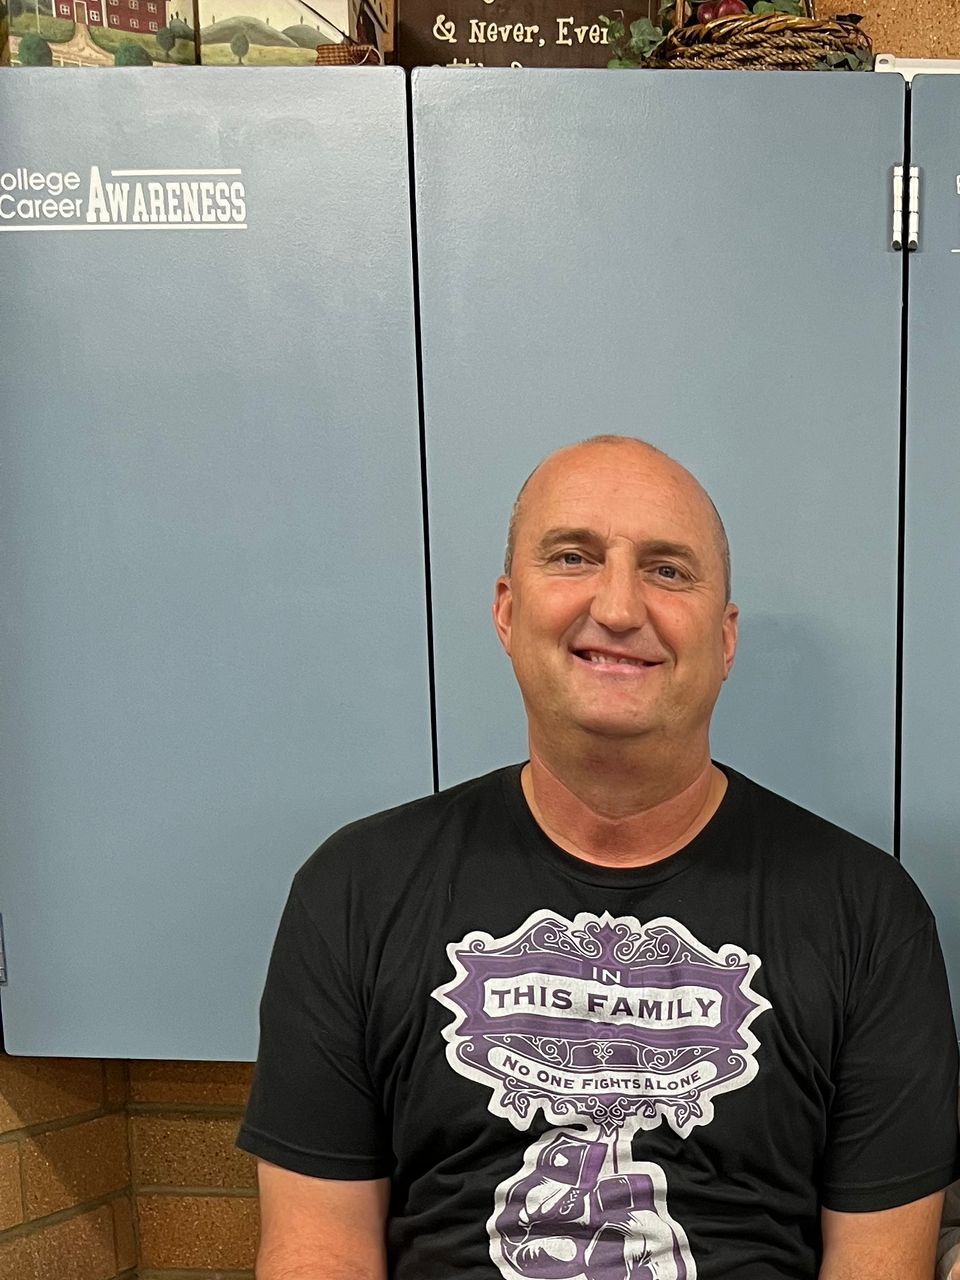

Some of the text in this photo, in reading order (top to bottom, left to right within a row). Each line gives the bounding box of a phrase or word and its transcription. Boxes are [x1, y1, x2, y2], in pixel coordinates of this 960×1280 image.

[433, 14, 456, 43] &
[469, 18, 546, 47] Never,
[0, 168, 81, 195] ollege
[0, 194, 83, 219] Career
[592, 966, 621, 984] IN
[491, 984, 716, 1021] THIS FAMILY
[502, 1054, 701, 1091] NO ONE FIGHTS ALONE
